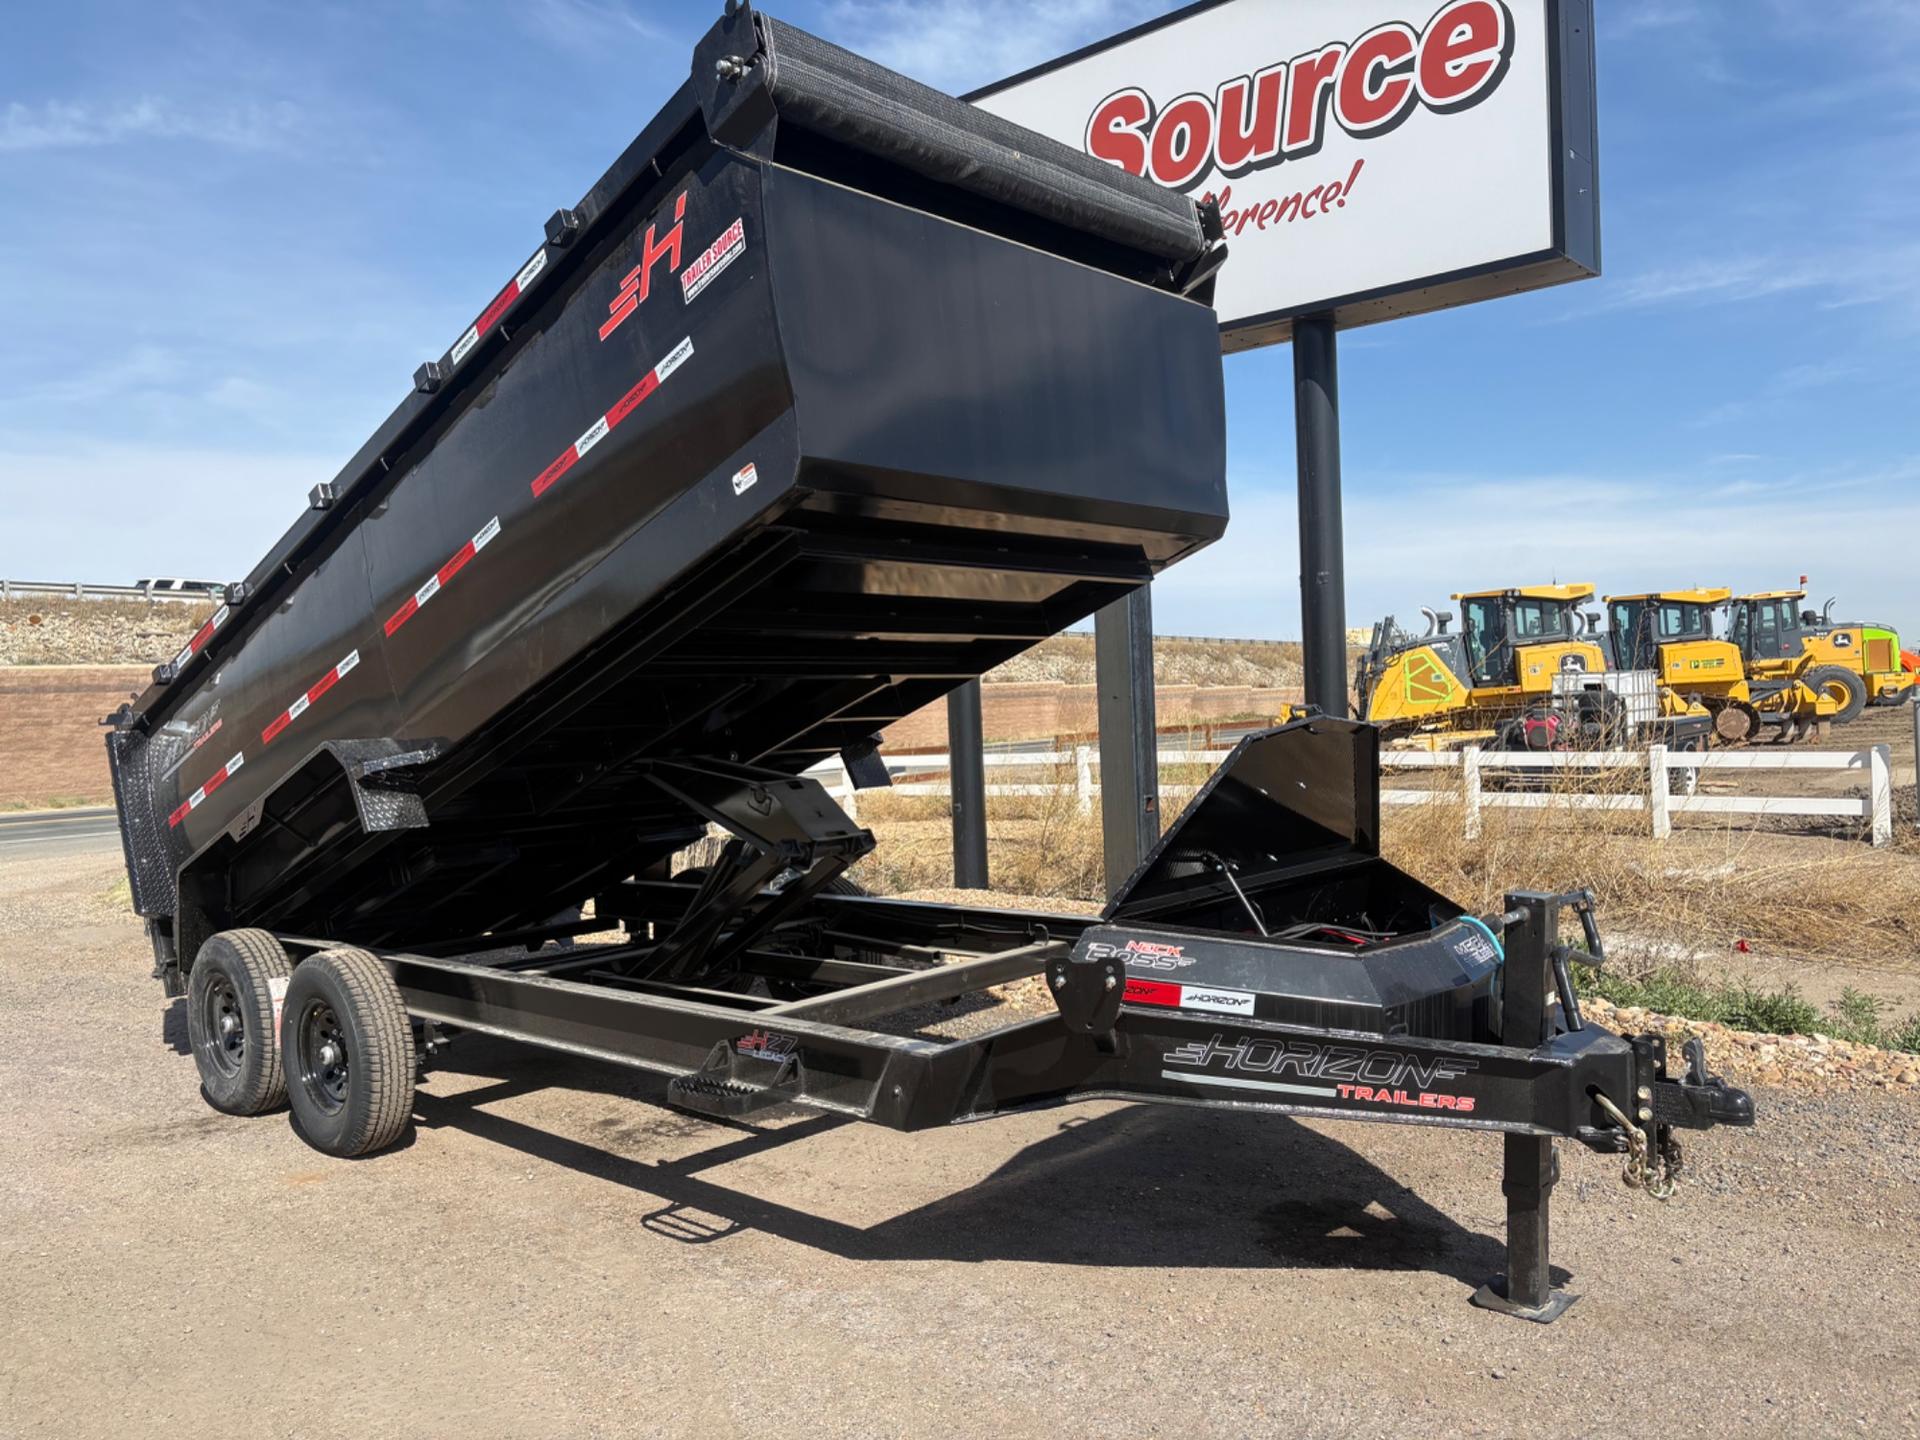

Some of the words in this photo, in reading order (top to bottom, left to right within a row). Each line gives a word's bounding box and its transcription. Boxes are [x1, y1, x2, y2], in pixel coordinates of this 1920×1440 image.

[1085, 0, 1512, 190] Source
[1201, 158, 1366, 240] erence!
[682, 249, 712, 290] TRAILER
[712, 219, 743, 261] SOURCE
[1085, 942, 1197, 971] BOSS
[1125, 940, 1184, 956] NECK
[1185, 993, 1251, 1008] HORIZON
[1163, 1033, 1480, 1089] HORIZON
[1337, 1084, 1475, 1110] TRAILERS
